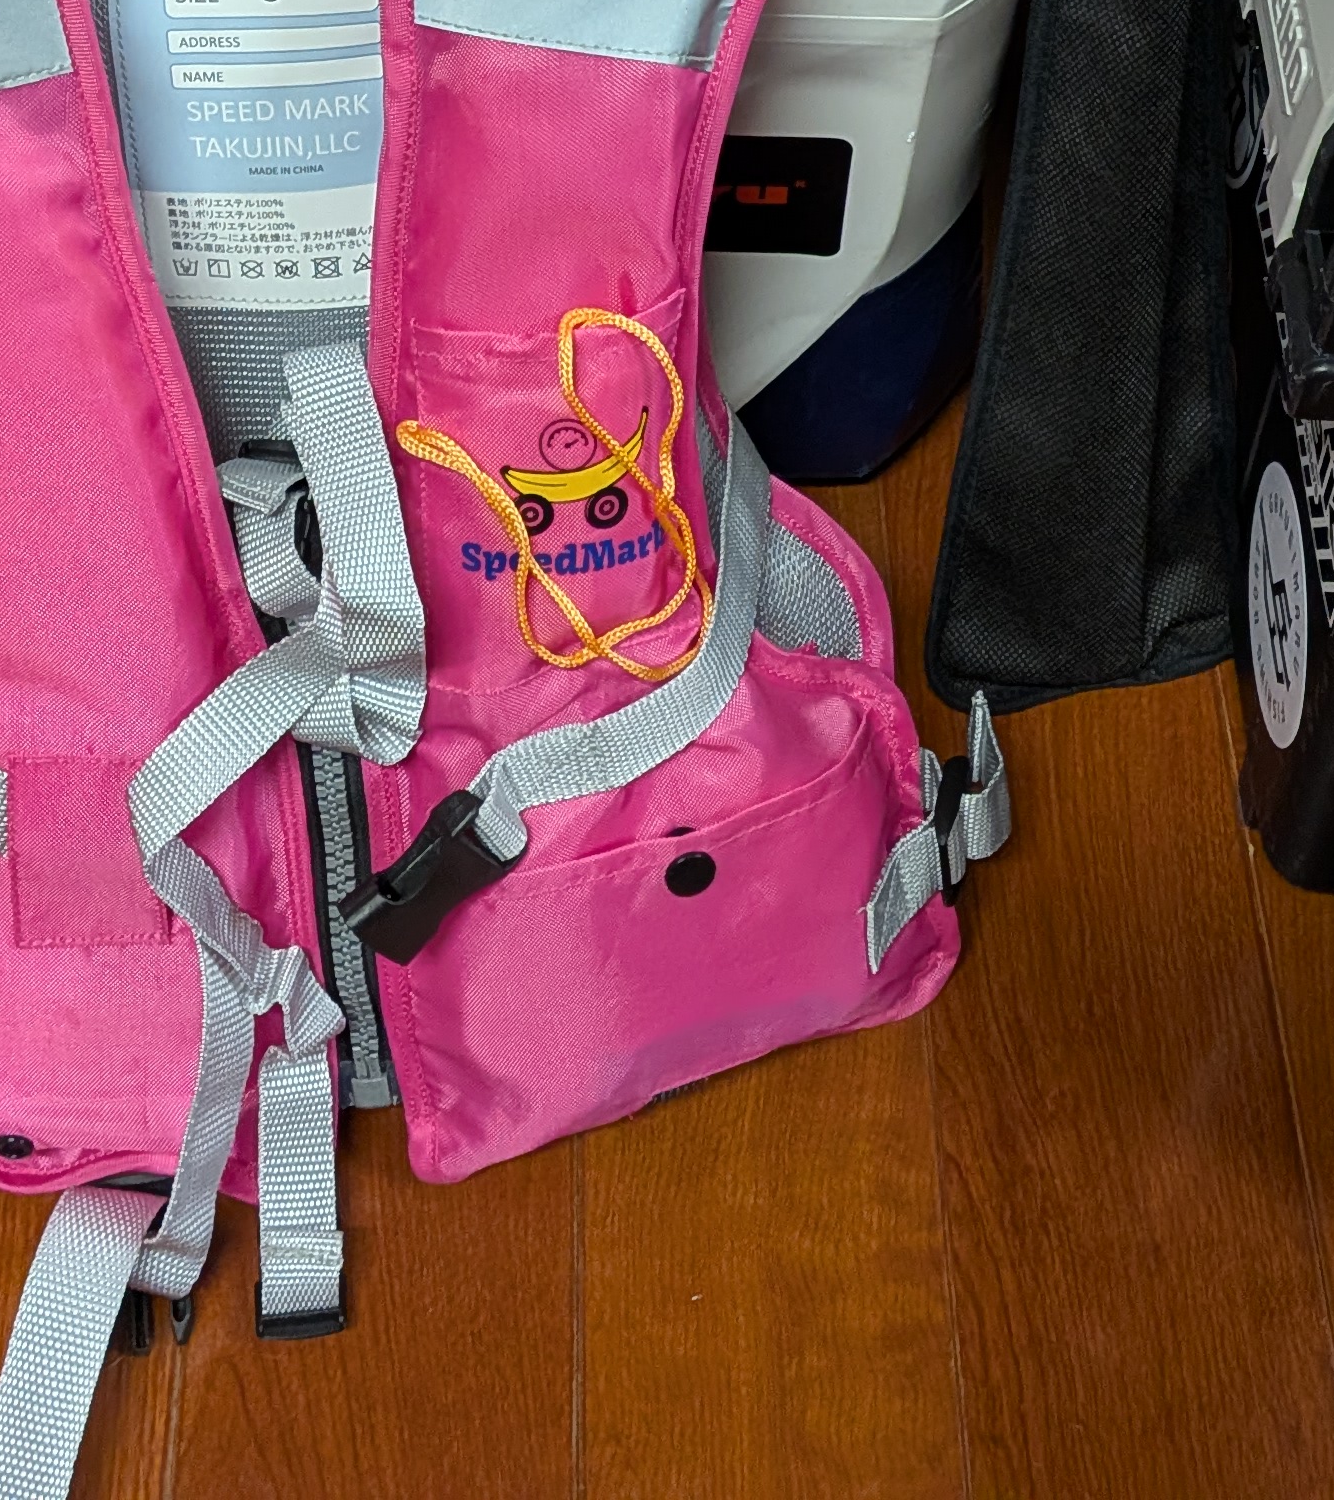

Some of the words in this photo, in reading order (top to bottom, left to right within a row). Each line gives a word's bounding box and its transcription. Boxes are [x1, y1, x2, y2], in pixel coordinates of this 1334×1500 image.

[179, 37, 241, 48] ADDRESS
[182, 71, 224, 83] NAME
[186, 100, 275, 123] SPEED
[285, 93, 371, 121] MARK
[189, 131, 361, 161] TAKUJIN,LLC
[248, 166, 278, 176] MADE
[280, 166, 291, 175] IN
[293, 164, 325, 175] CHINA
